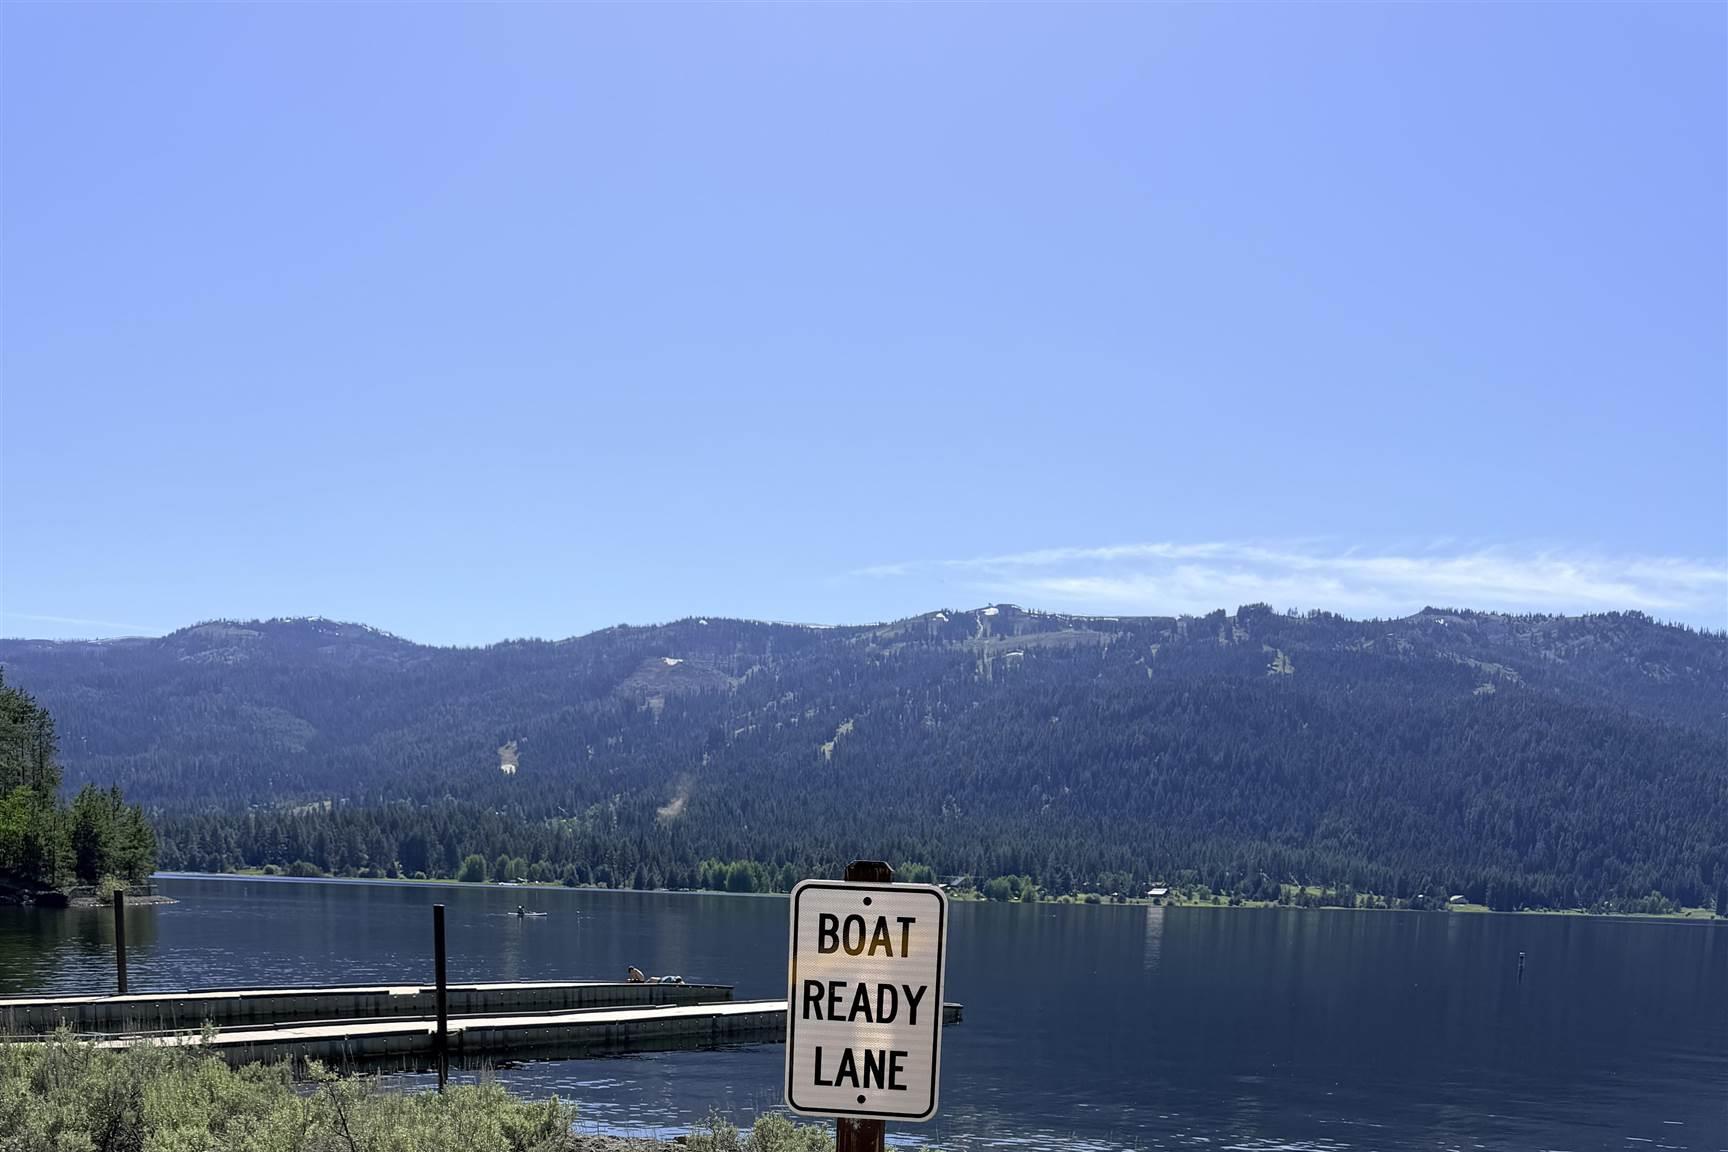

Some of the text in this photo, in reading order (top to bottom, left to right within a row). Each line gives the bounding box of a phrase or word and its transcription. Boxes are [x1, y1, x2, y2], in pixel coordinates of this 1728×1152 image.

[817, 912, 916, 958] BOAT
[802, 979, 928, 1026] READY
[813, 1046, 909, 1091] LANE
